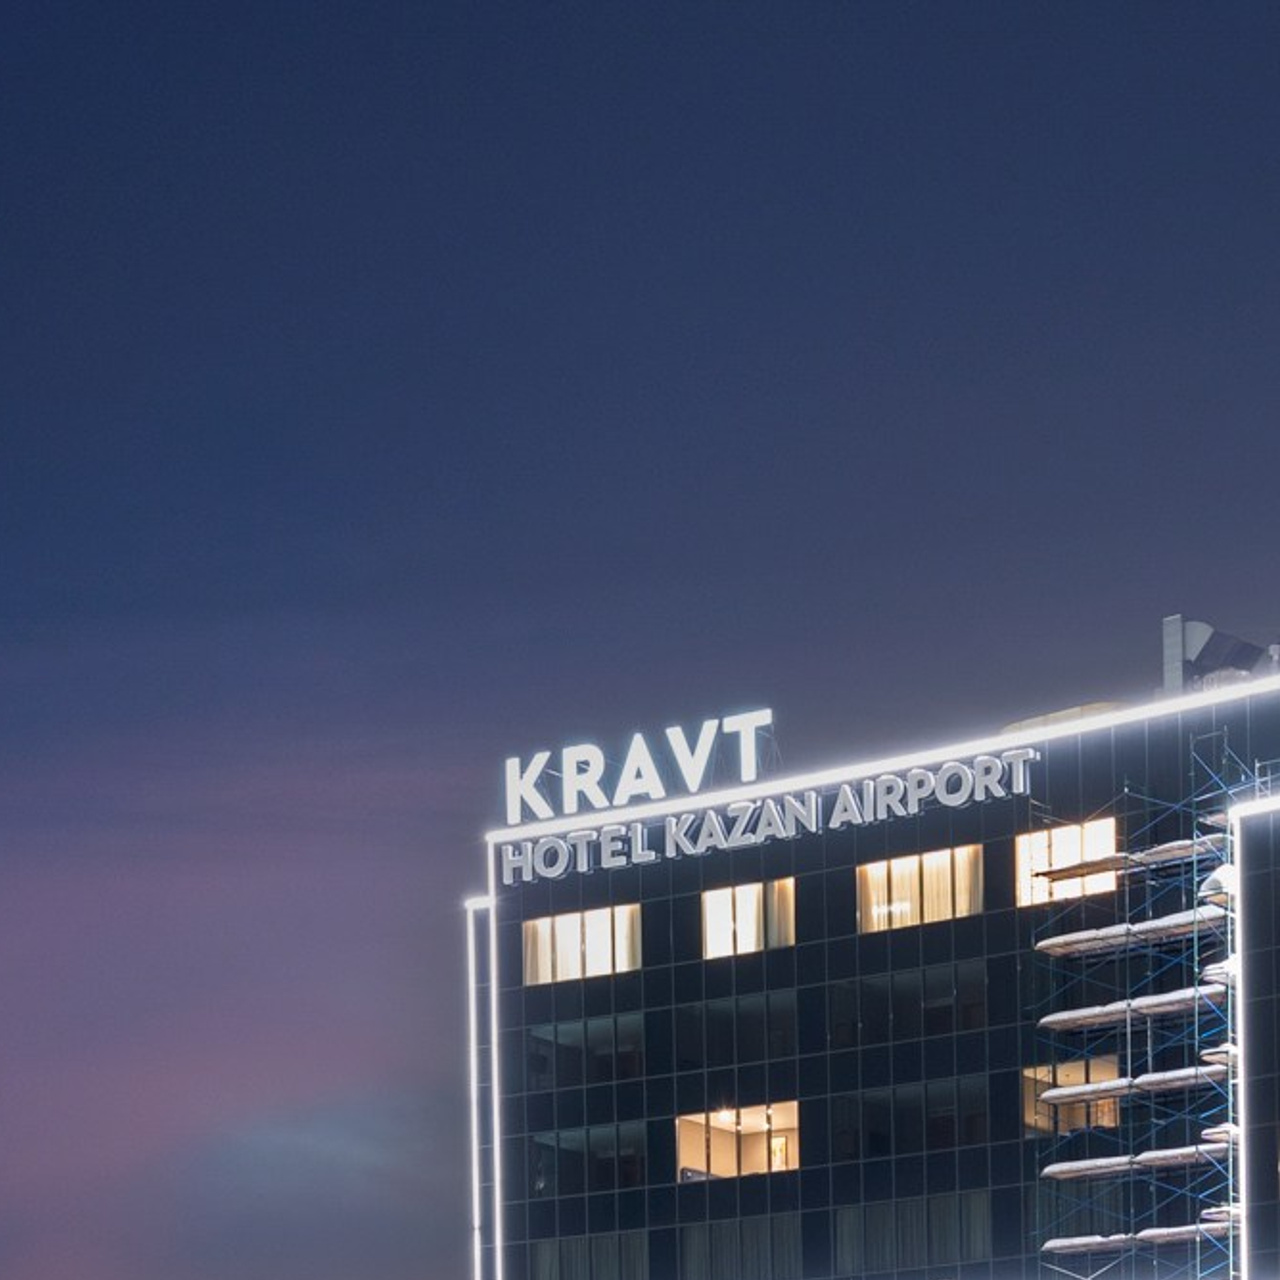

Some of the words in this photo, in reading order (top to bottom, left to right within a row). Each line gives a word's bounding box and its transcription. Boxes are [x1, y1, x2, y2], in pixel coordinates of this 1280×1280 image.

[502, 822, 657, 885] HOTEL
[665, 790, 820, 860] KAZAN
[829, 748, 1040, 829] AIRPORT
[504, 707, 773, 826] KRAVT
